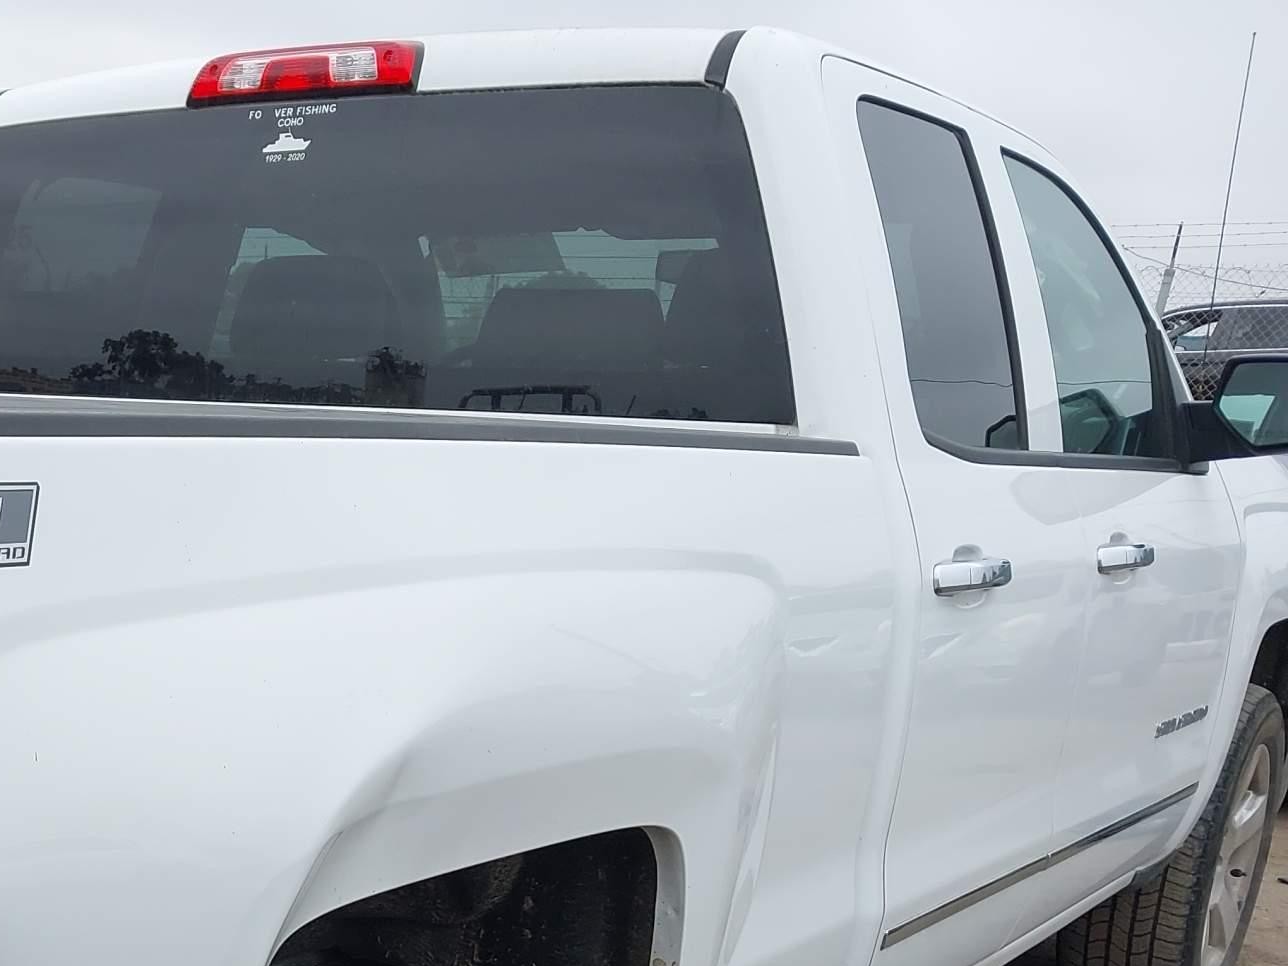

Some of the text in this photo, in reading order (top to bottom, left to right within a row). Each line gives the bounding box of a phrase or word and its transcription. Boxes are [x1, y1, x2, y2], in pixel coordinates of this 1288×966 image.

[296, 103, 337, 116] FISHING
[277, 117, 304, 127] COHO
[265, 153, 282, 163] 1929
[287, 152, 306, 161] 2020
